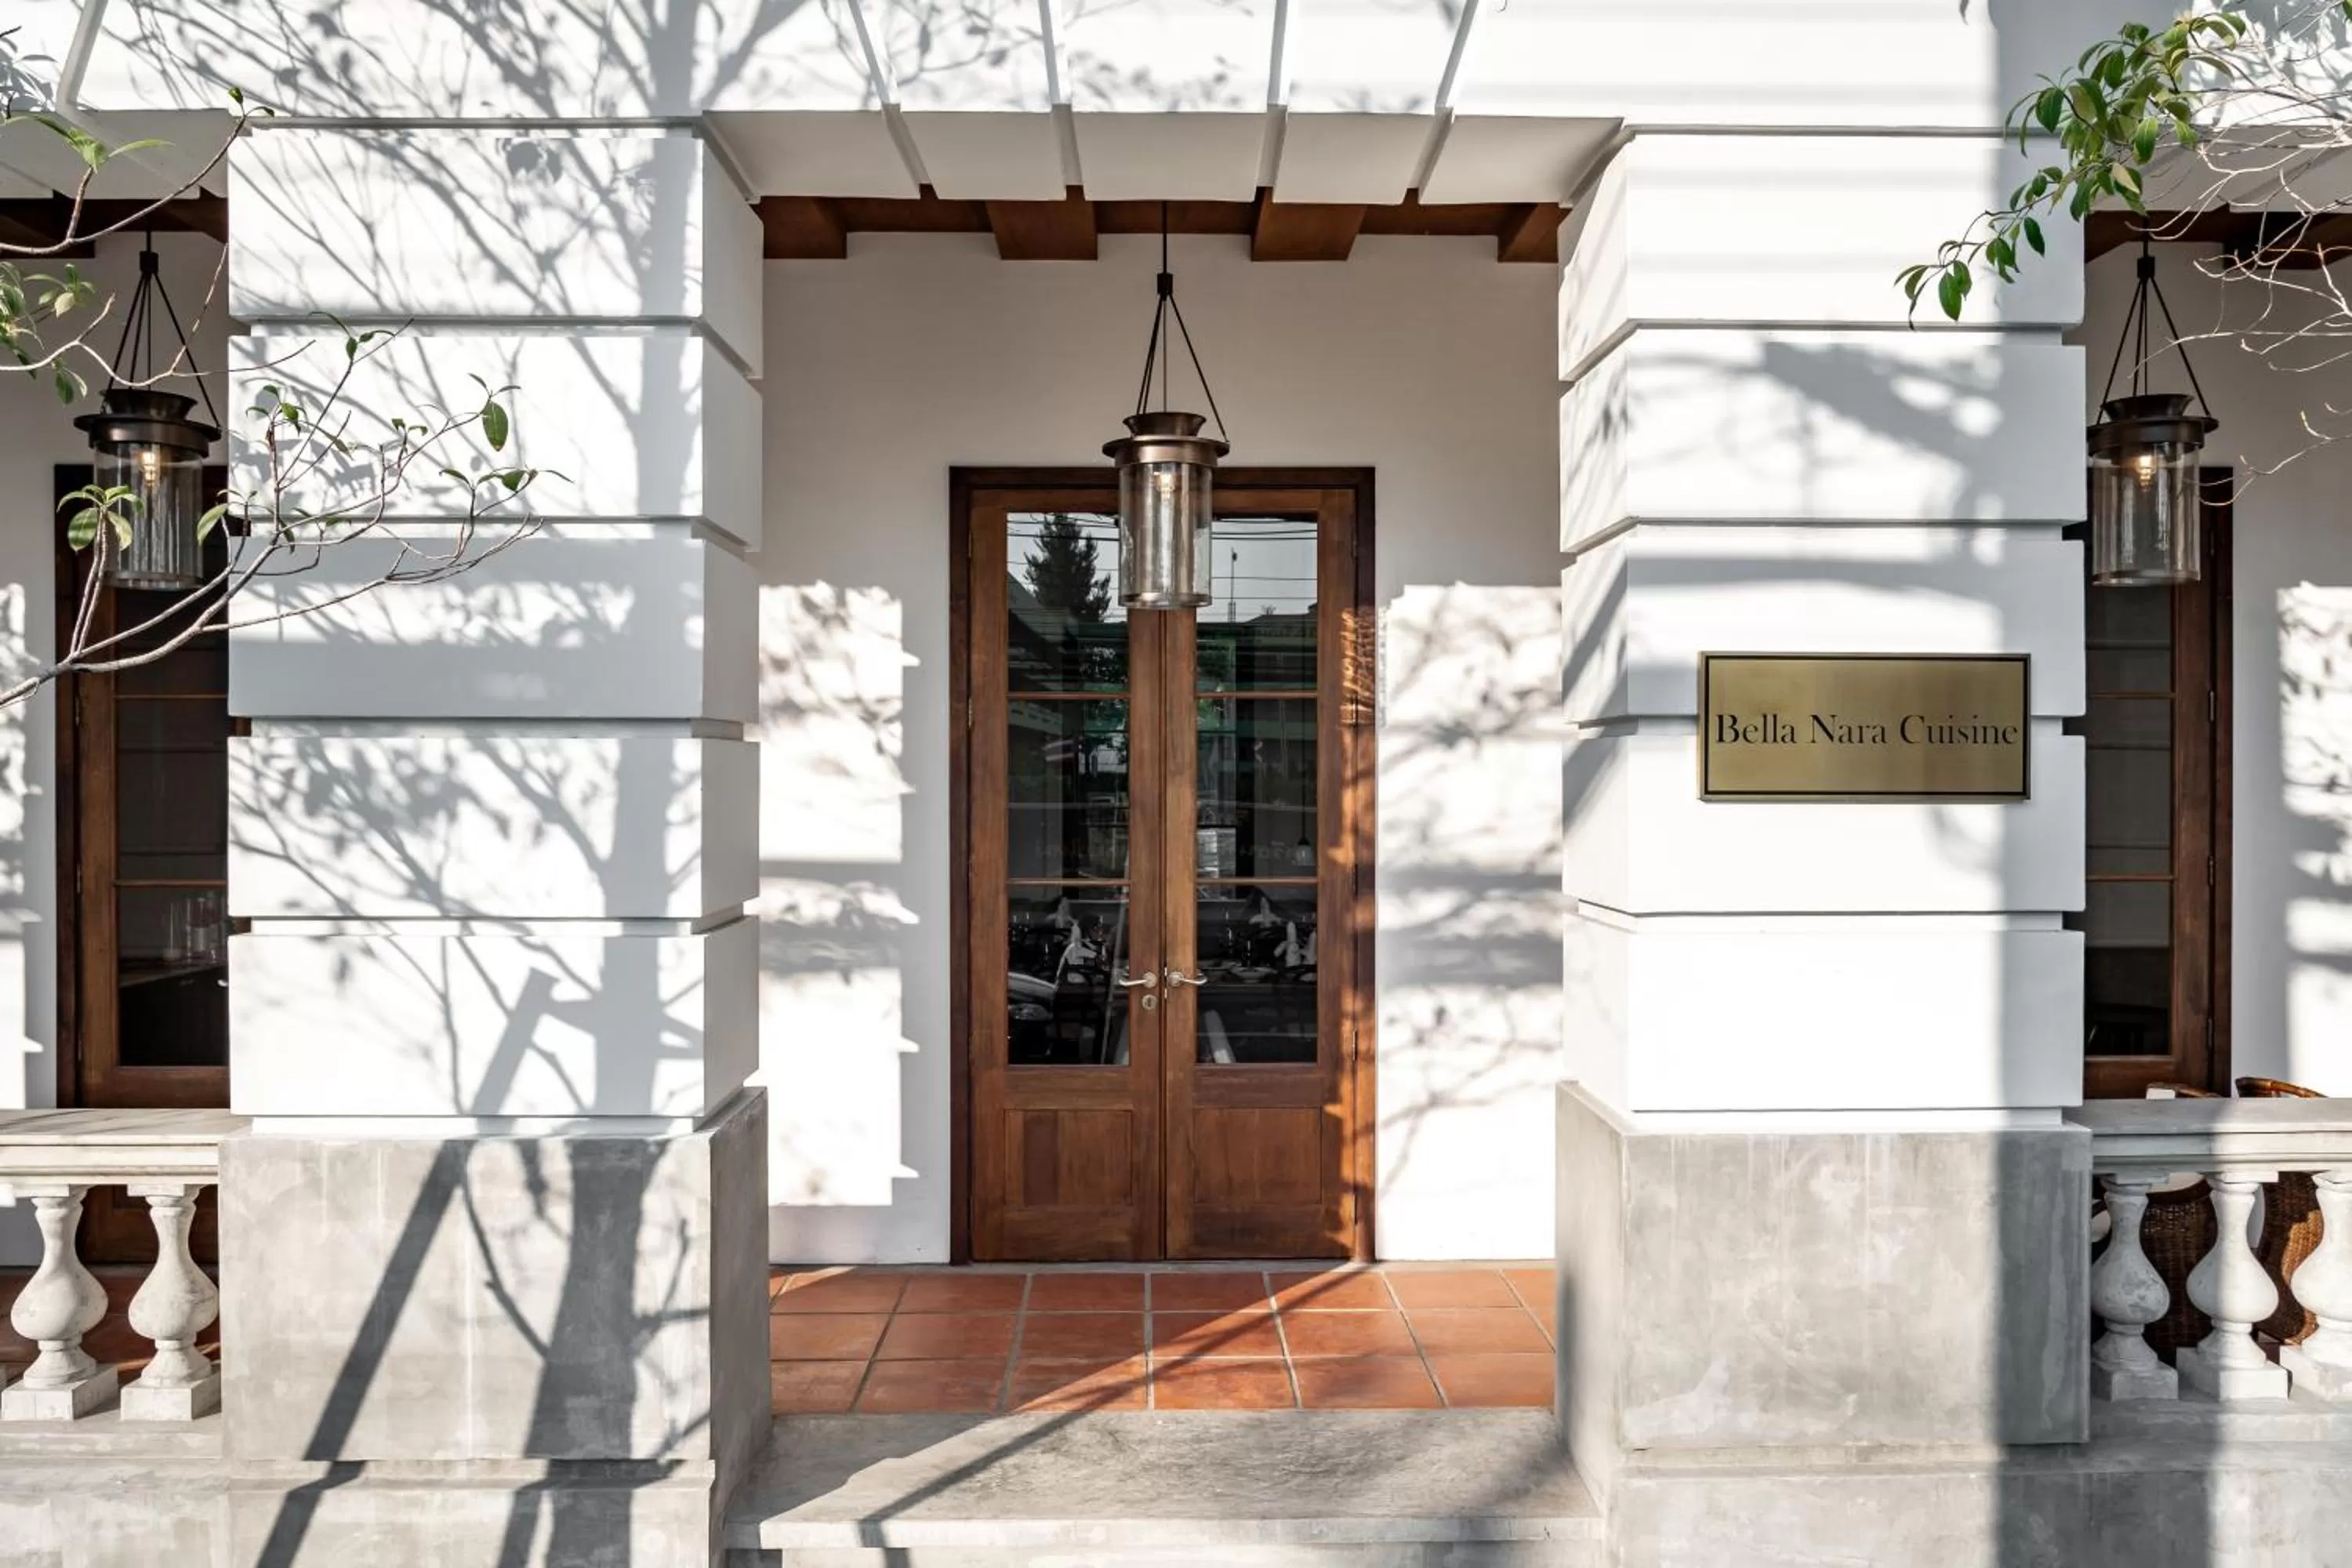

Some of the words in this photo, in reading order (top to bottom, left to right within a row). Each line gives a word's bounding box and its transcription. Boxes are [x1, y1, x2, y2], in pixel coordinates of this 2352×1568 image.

[1715, 713, 1797, 744] Bella
[1807, 714, 1887, 744] Nara
[1899, 714, 2019, 745] Cuisine
